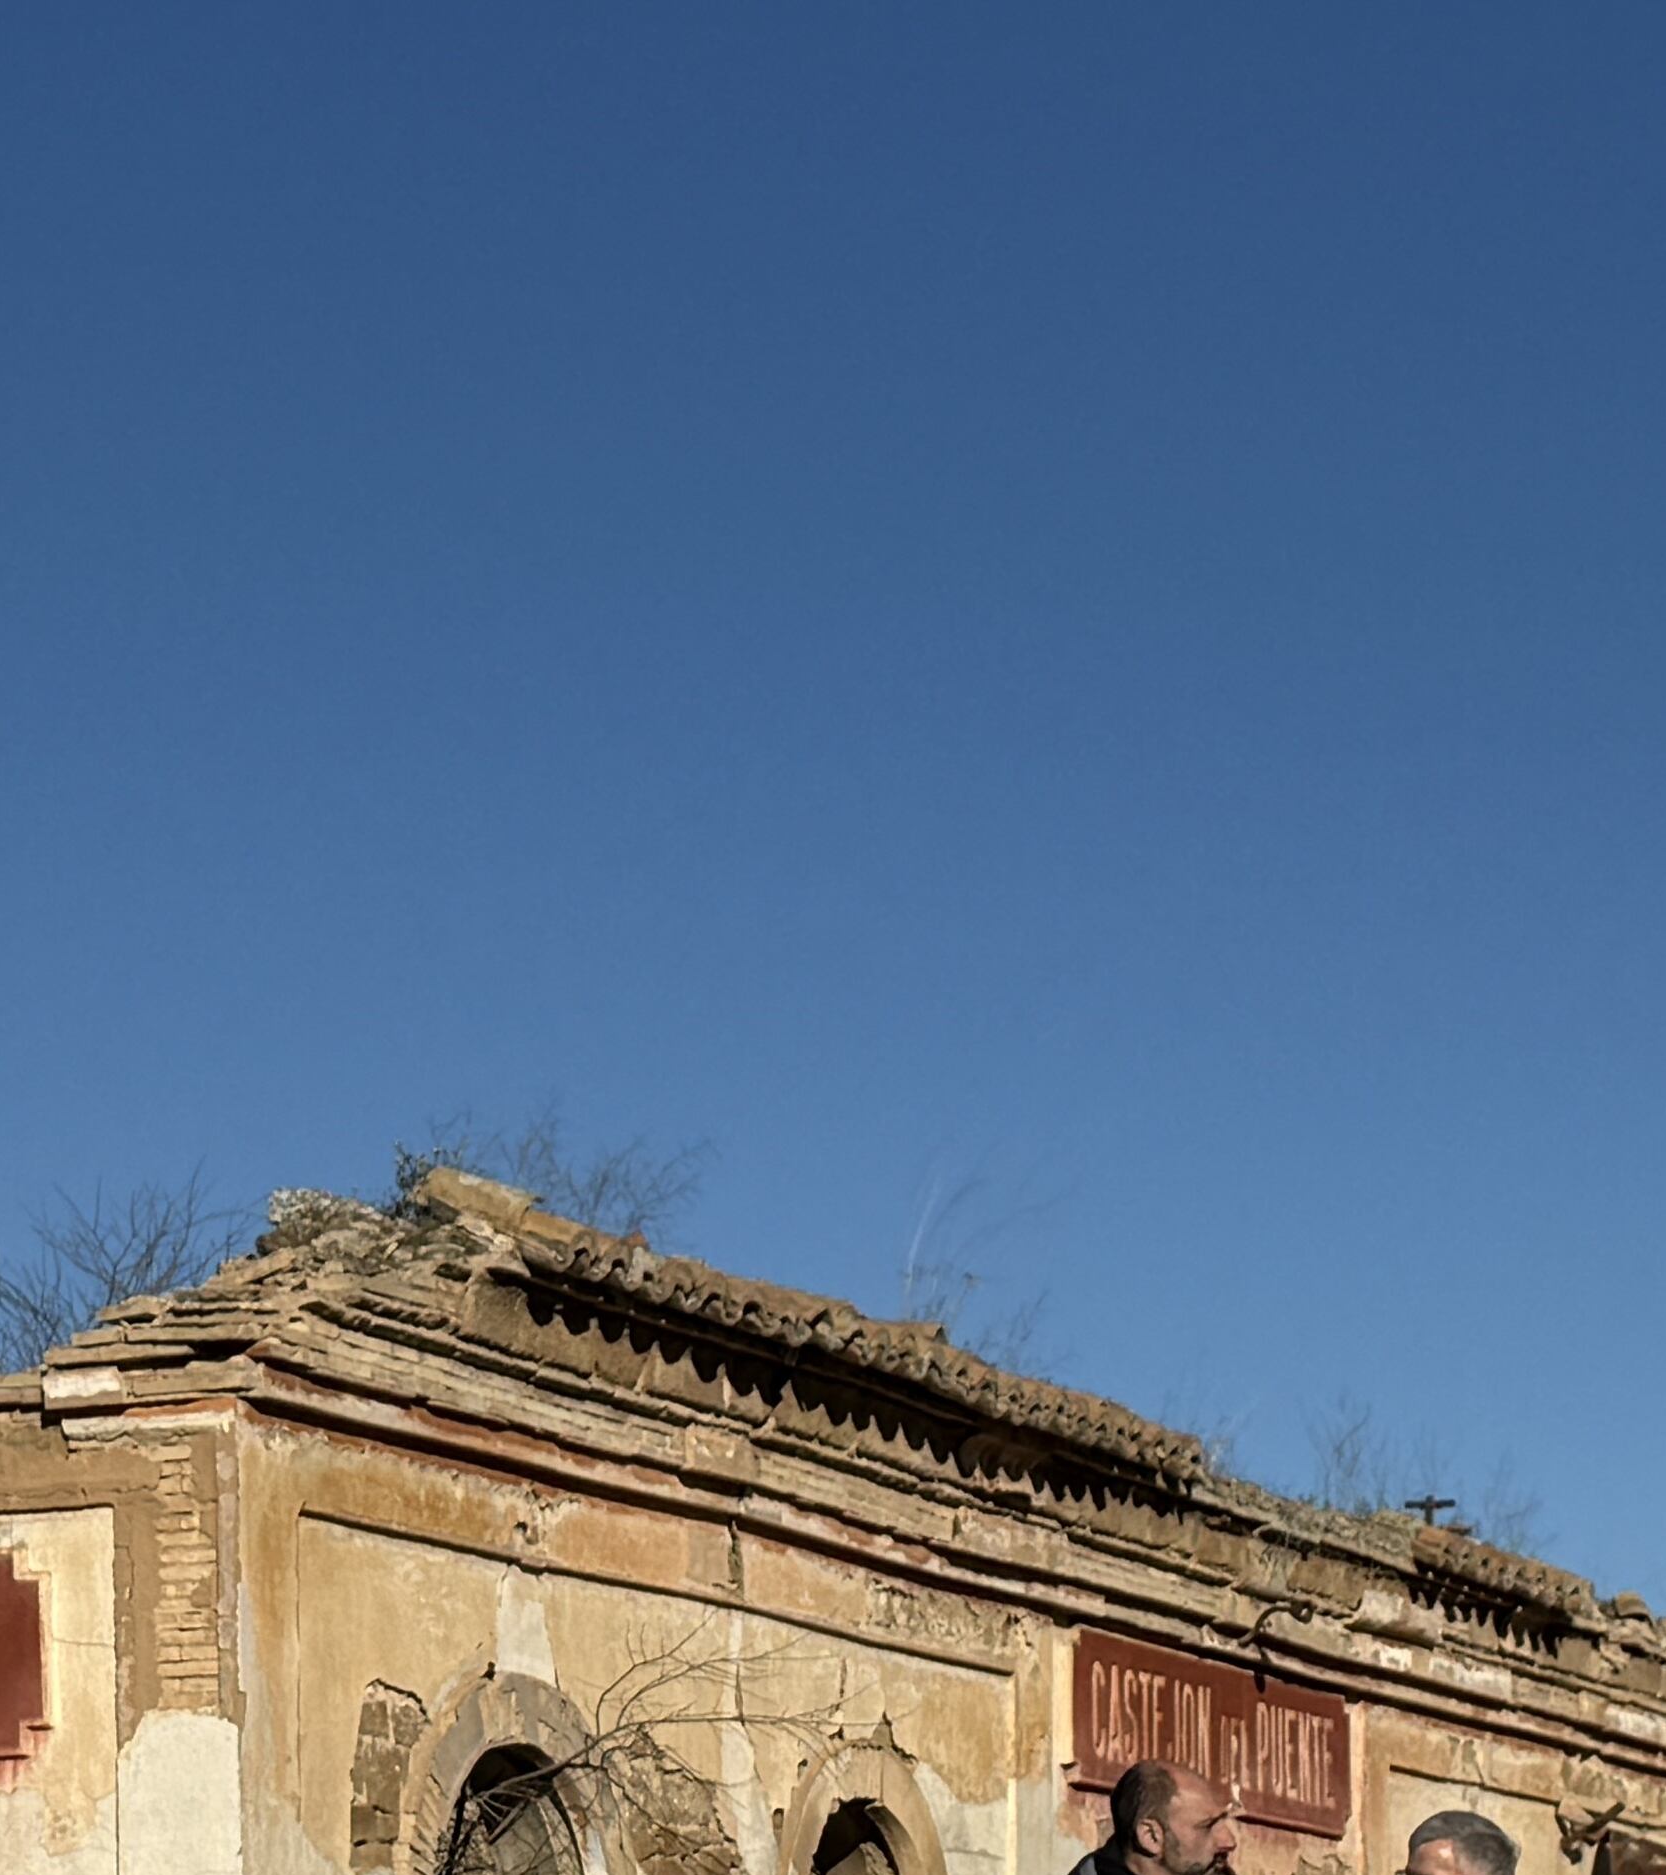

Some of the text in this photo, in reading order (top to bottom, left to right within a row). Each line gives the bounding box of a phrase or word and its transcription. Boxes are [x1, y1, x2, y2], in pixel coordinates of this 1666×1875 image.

[1091, 1660, 1336, 1809] CASTEJON DEL PUENTE
